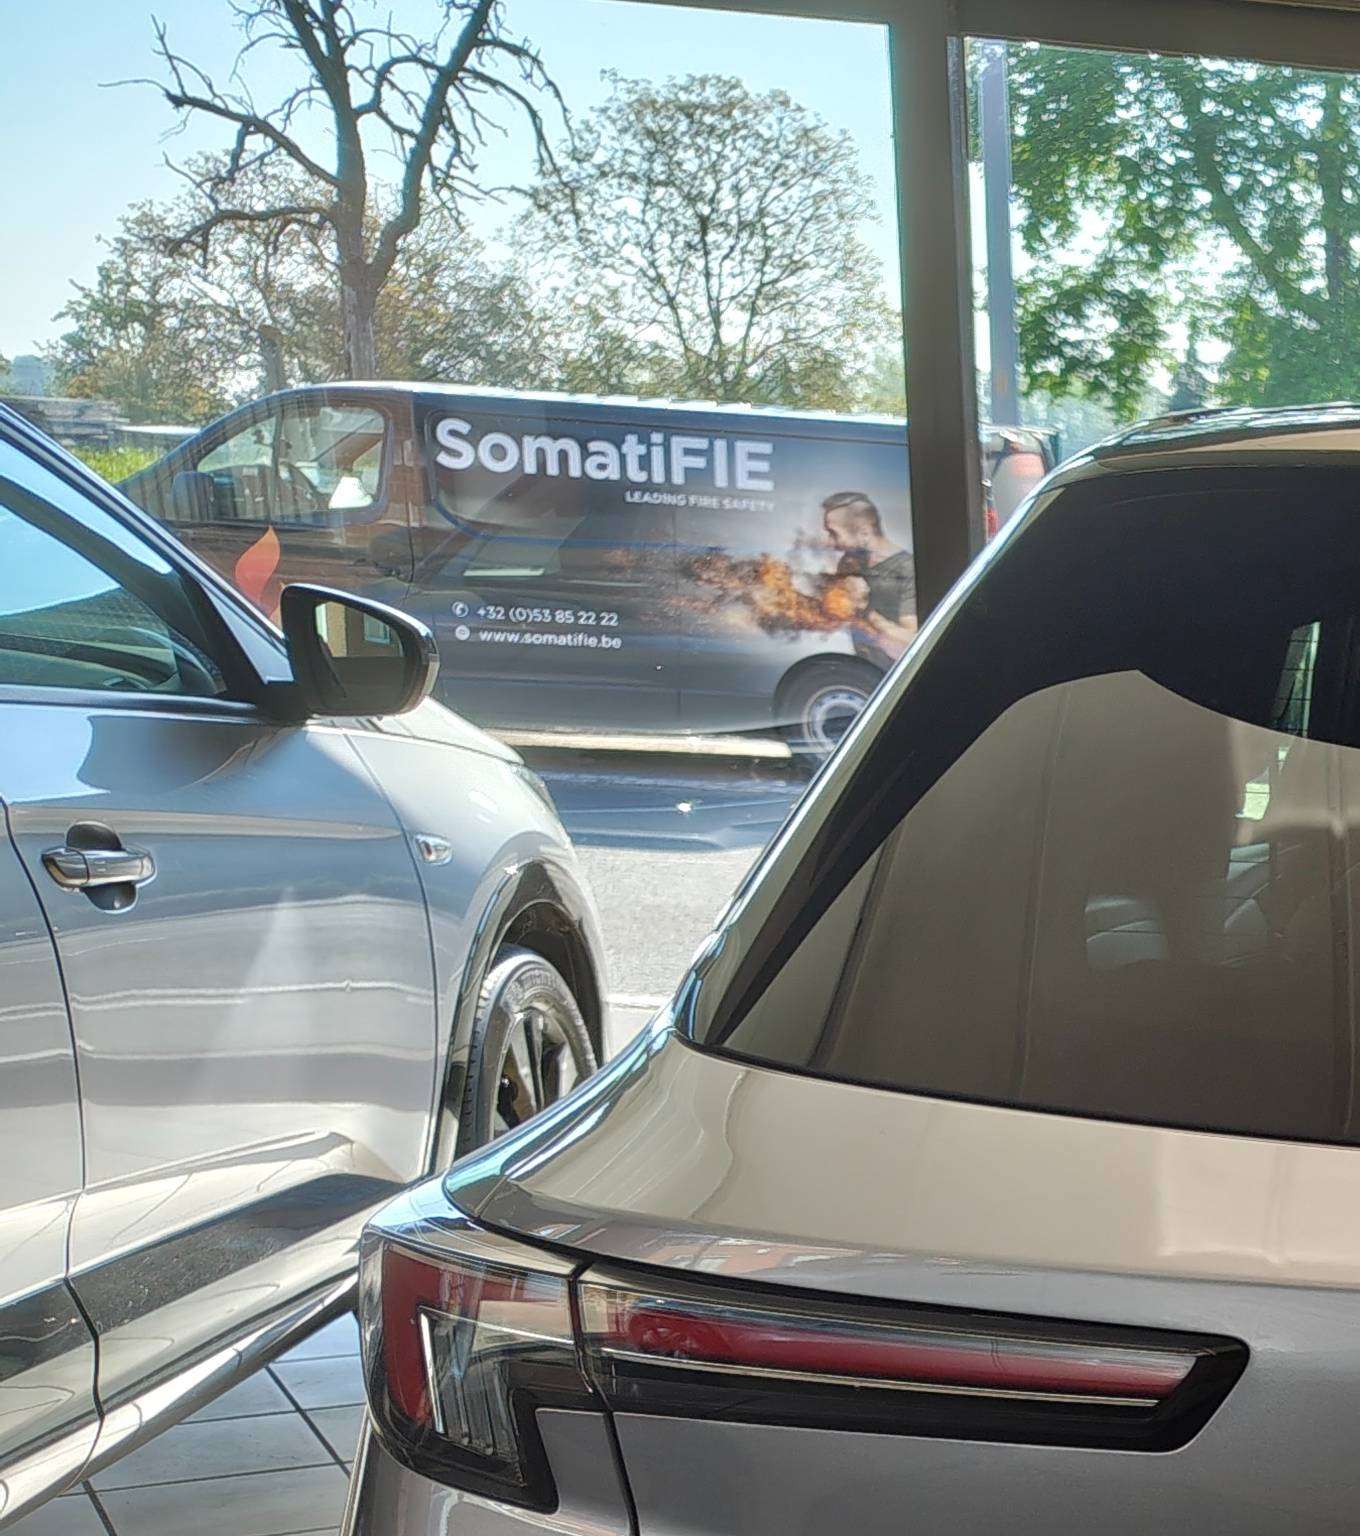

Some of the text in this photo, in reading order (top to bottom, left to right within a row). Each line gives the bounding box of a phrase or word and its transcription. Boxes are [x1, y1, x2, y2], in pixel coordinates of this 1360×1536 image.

[435, 417, 775, 491] SomatiFIE
[624, 490, 687, 507] LEADING
[688, 493, 720, 509] FIRE
[476, 605, 619, 627] +32 (0)53 85 22 22
[478, 629, 622, 649] www.somatifie.be
